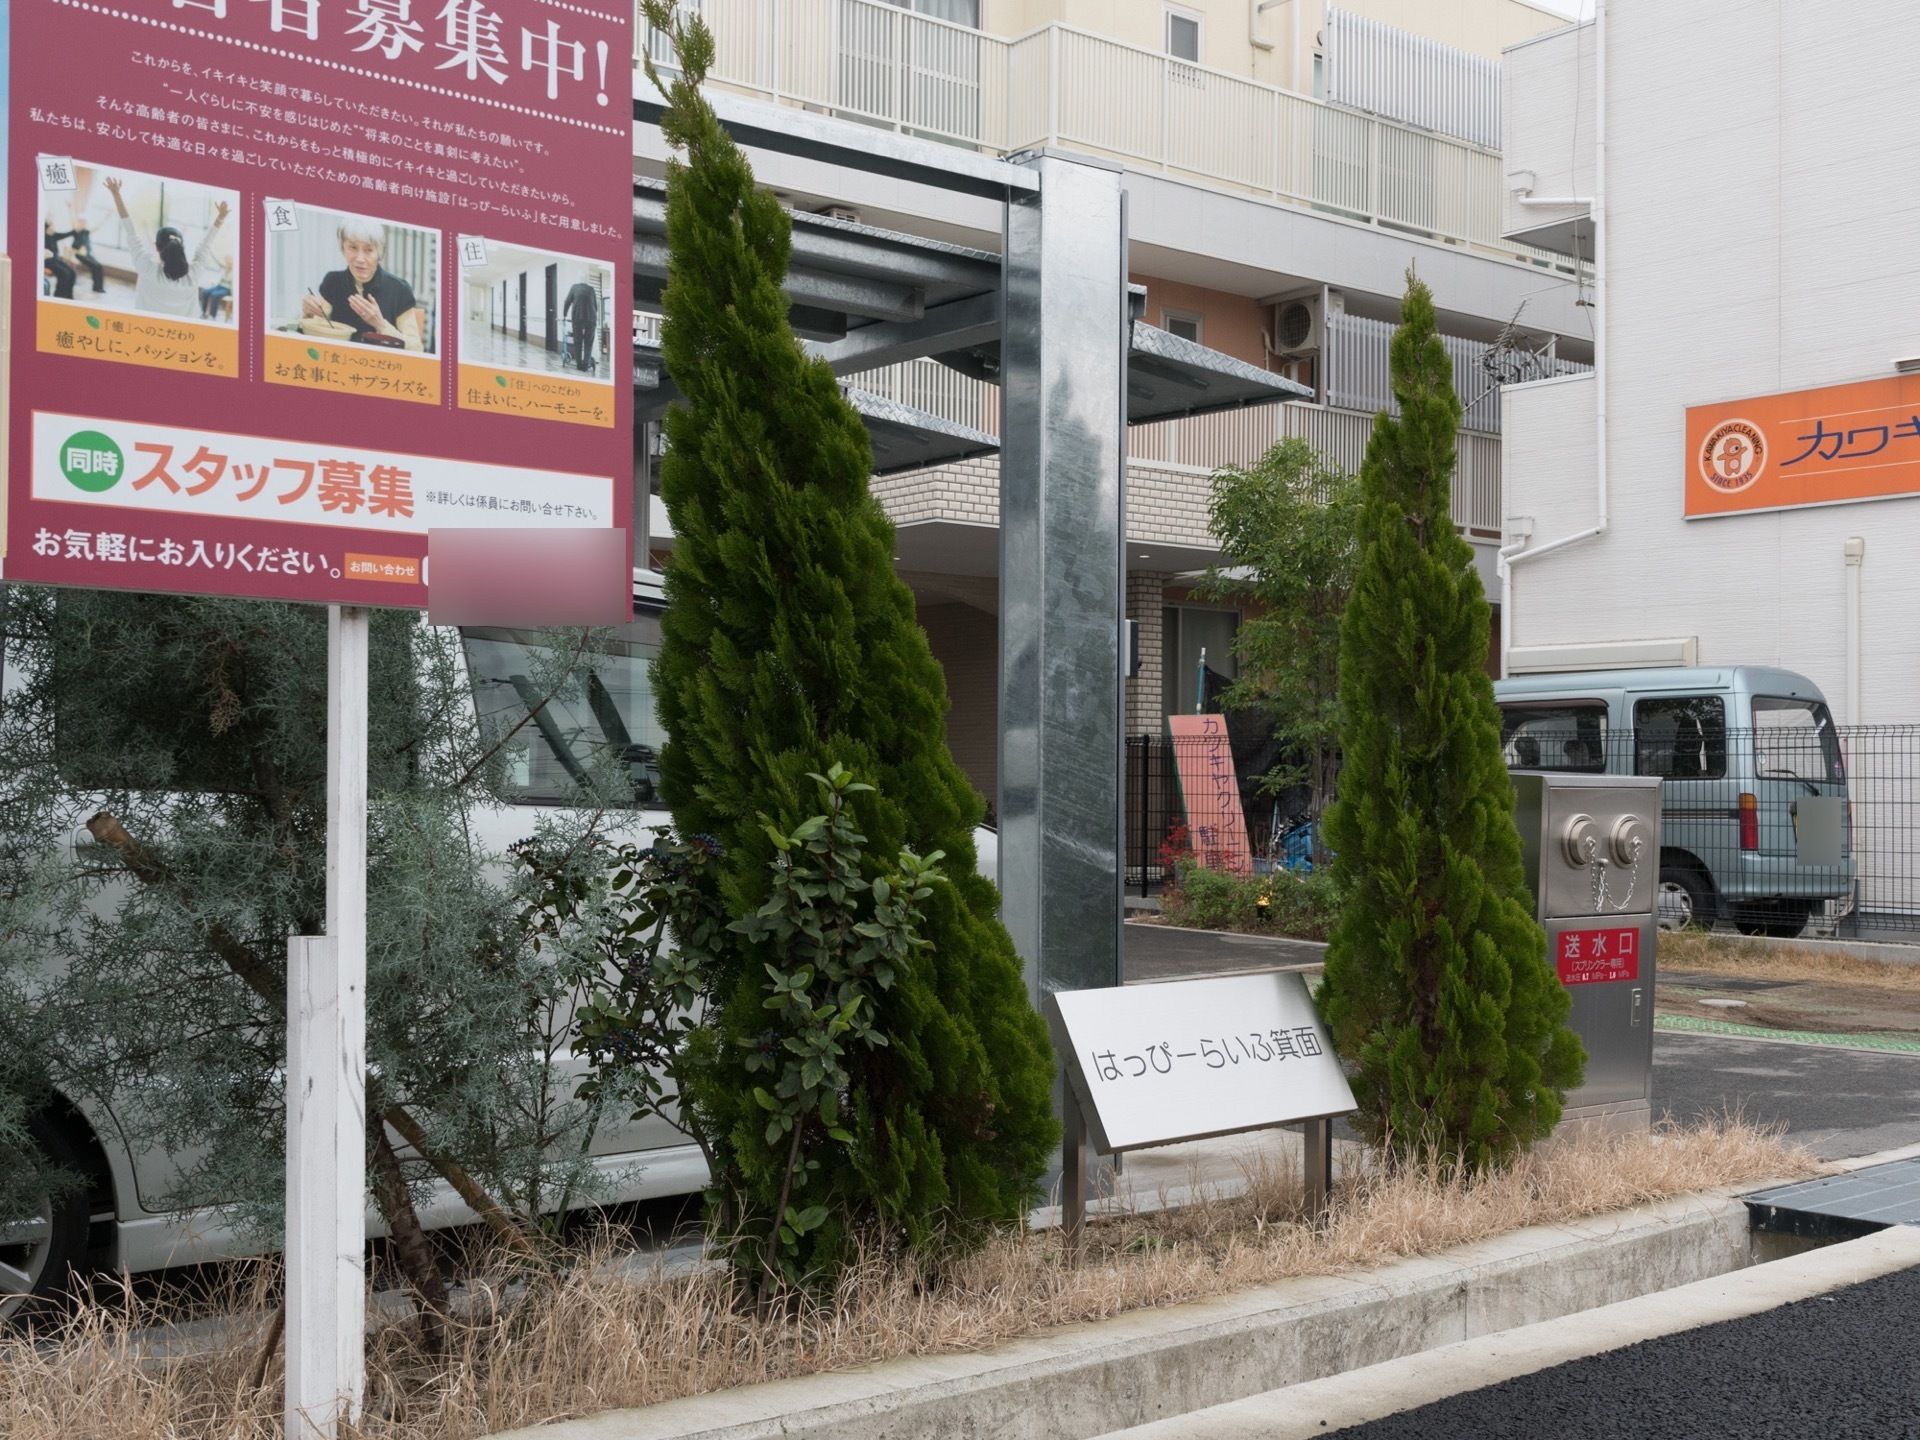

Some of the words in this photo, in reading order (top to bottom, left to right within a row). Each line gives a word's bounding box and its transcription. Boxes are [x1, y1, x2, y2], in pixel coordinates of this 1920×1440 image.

[172, 0, 609, 107] 募集中!
[131, 50, 549, 156] これからを、イキイキと笑顔で暮らしていただきたい。それが私たちの願いです。
[45, 162, 71, 185] 癒
[272, 205, 292, 227] 食
[464, 242, 484, 262] 住
[55, 330, 225, 370] 癒やしに、パッションを。
[274, 362, 434, 399] お食事に、サプライズを。
[467, 388, 609, 422] 住まいに、ハーモニーを。
[66, 447, 119, 477] 同時
[131, 441, 415, 519] スタッフ募集
[32, 527, 341, 579] お気軽にお入りください。
[350, 560, 416, 578] お問い合わせ
[1565, 932, 1633, 958] 送水口
[1092, 1026, 1323, 1082] はっぴーらいふ箕面
